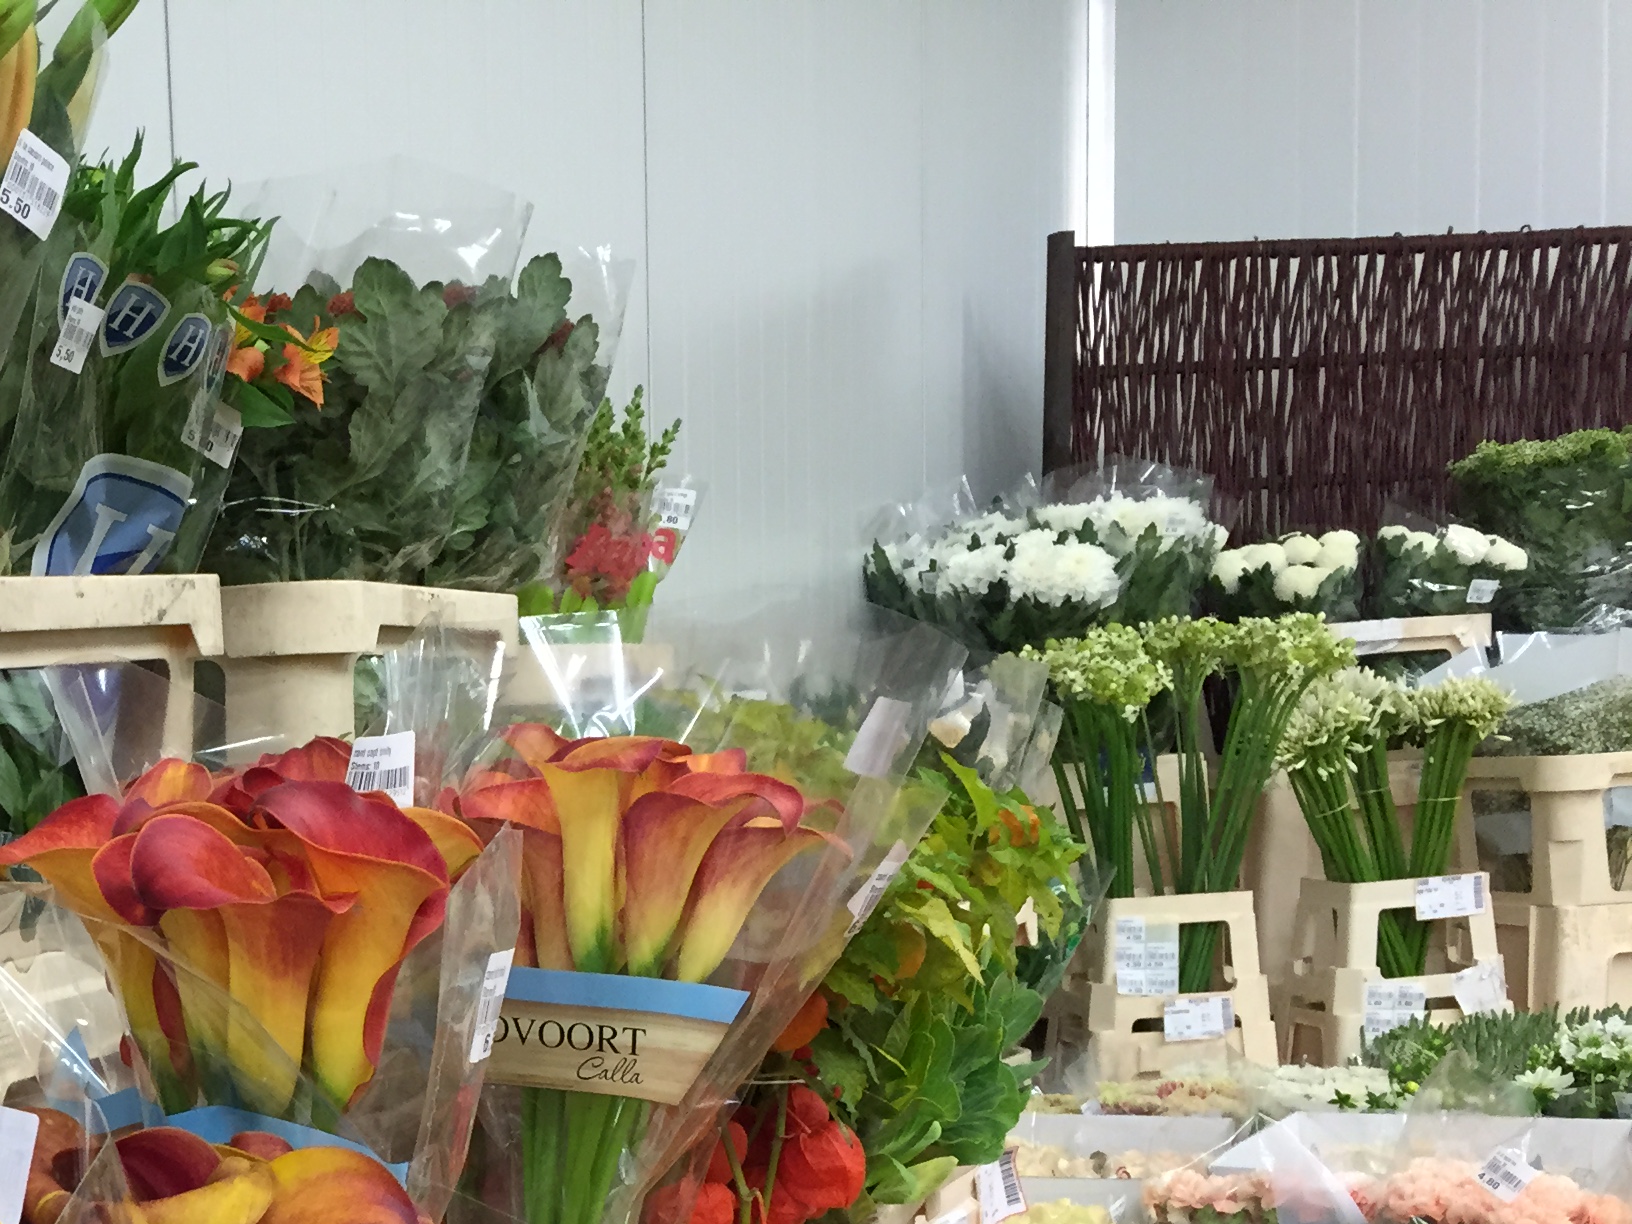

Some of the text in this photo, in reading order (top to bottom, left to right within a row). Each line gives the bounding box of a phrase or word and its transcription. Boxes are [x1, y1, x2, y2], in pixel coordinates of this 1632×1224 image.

[0, 187, 31, 219] 5.50
[108, 293, 155, 339] H
[168, 324, 205, 366] H
[576, 1056, 644, 1085] Calla
